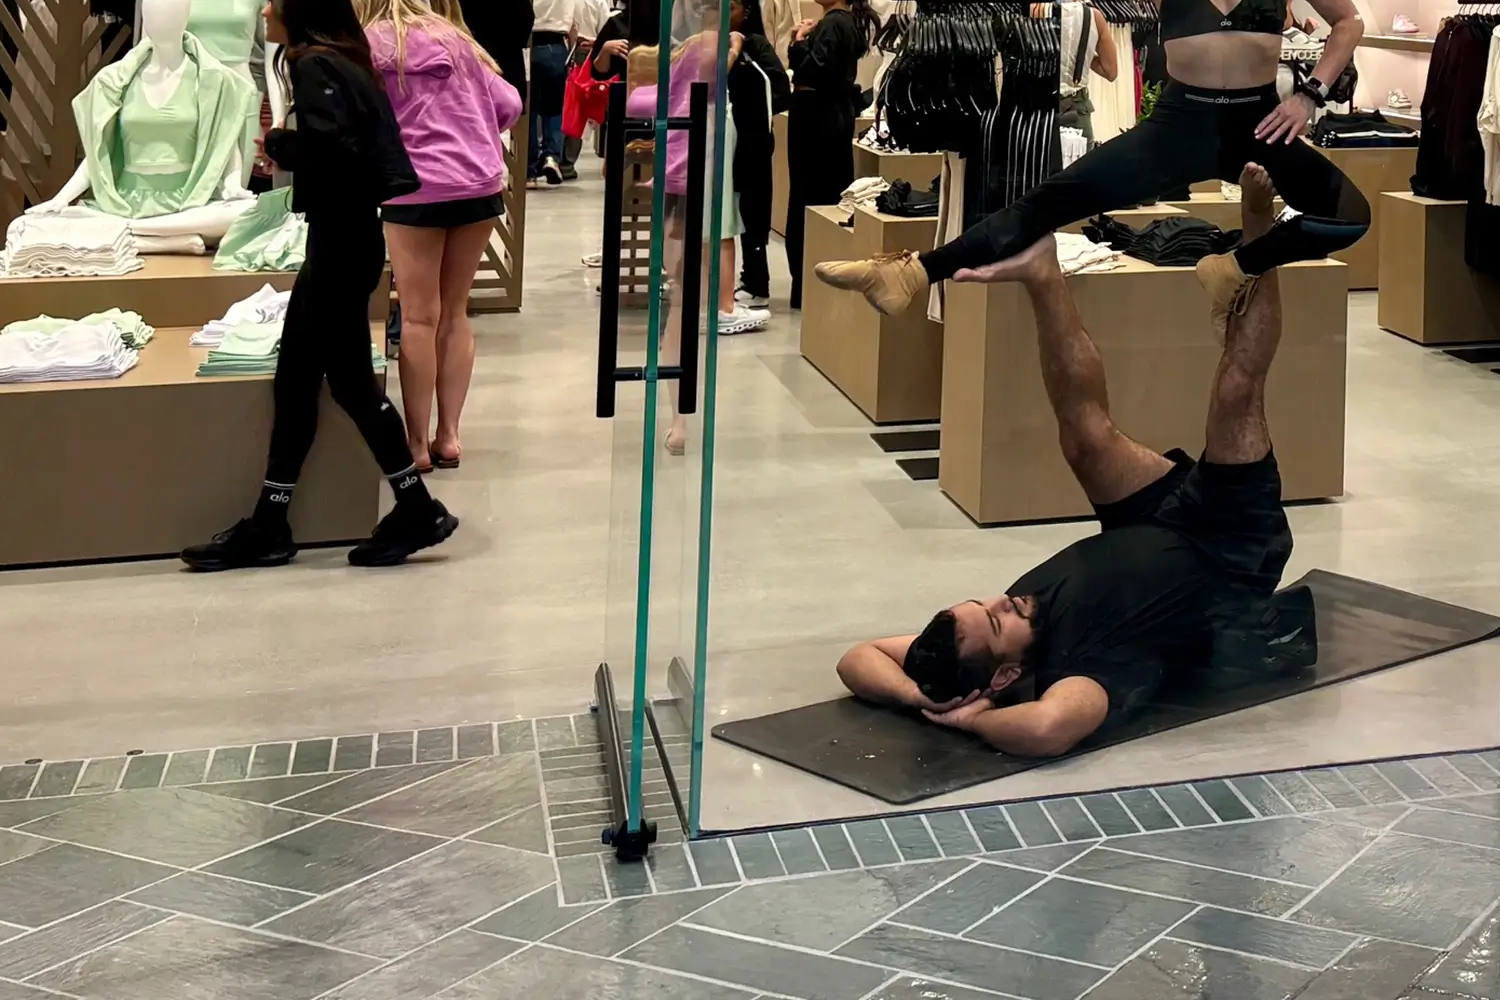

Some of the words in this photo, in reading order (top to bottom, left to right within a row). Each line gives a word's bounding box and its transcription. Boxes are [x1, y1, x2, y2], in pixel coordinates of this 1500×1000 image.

[1220, 17, 1233, 27] alo
[1215, 95, 1230, 104] alo
[399, 475, 418, 489] alo
[269, 491, 290, 503] alo
